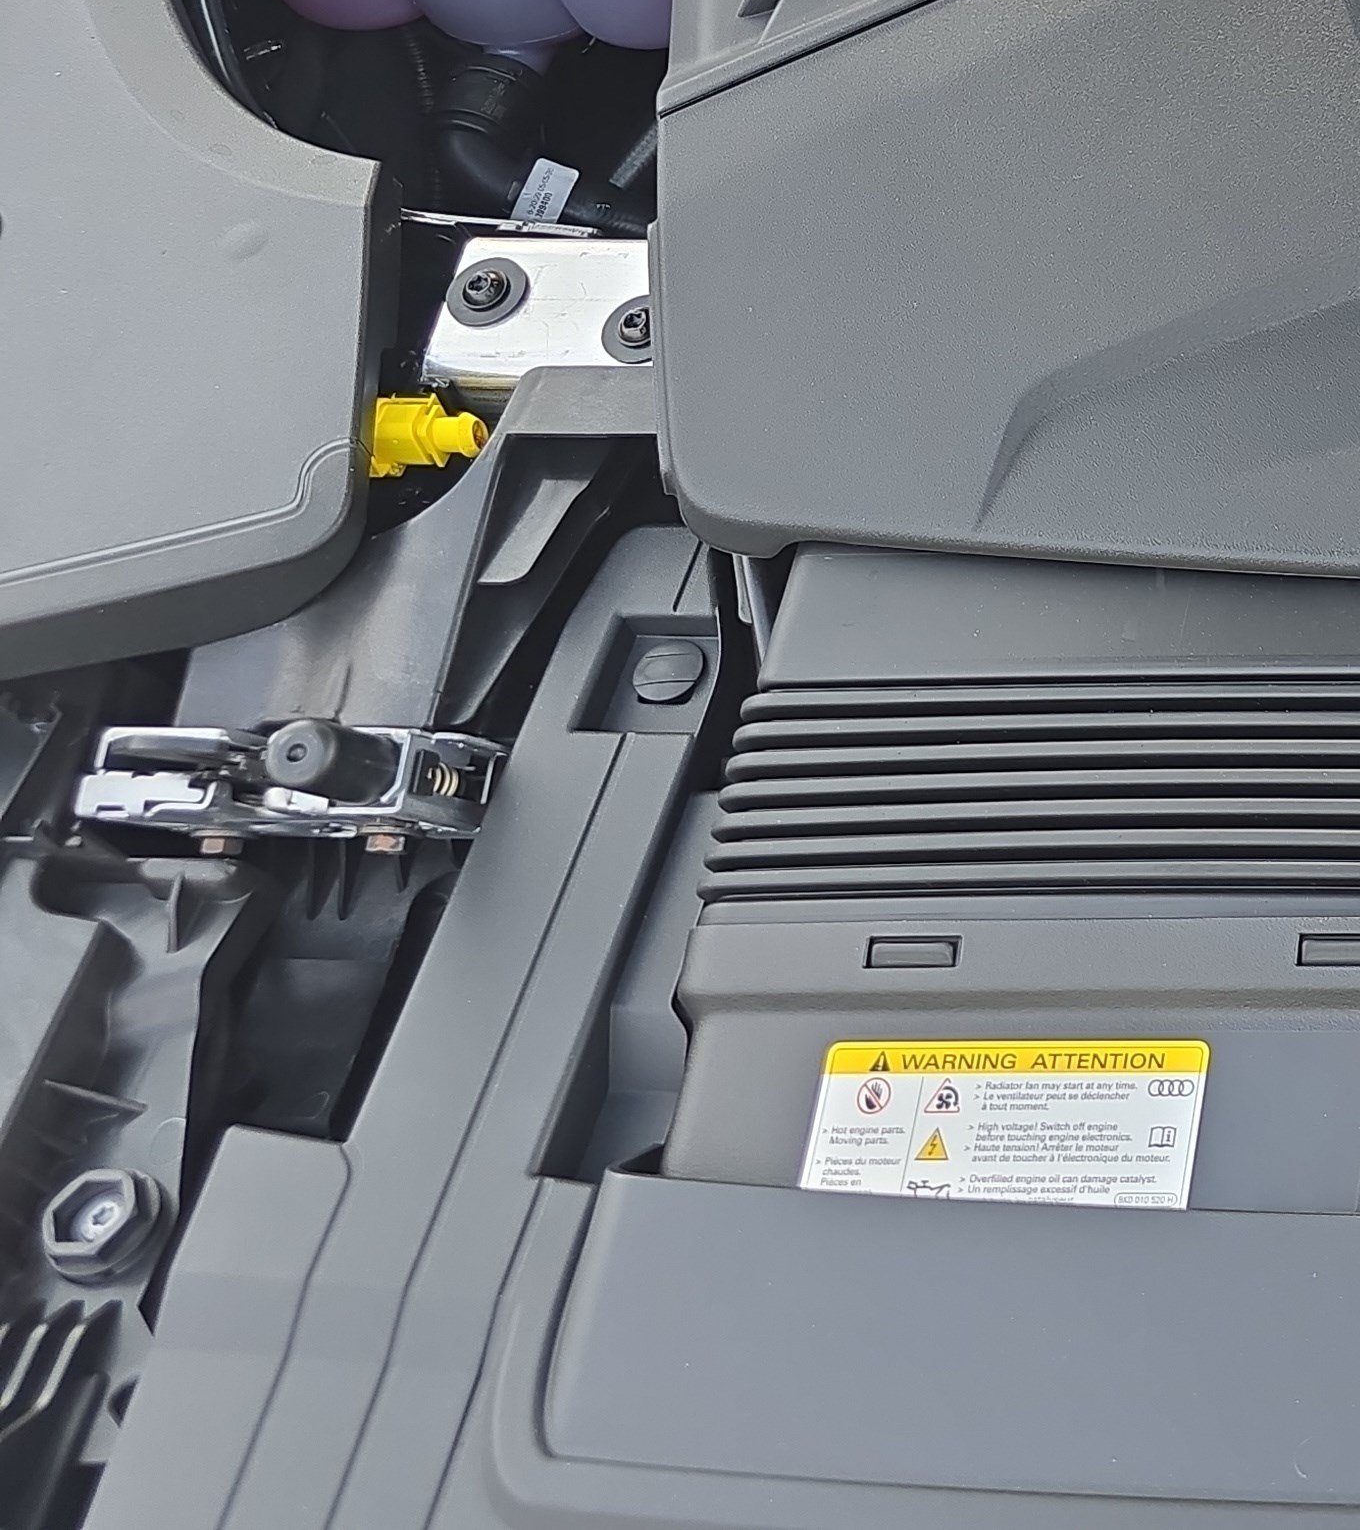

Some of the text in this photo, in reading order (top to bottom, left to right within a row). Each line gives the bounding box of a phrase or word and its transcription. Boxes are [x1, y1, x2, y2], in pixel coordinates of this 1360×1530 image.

[902, 1053, 1166, 1070] WARNING ATTENTION
[985, 1081, 1138, 1092] Radiator fan may start at any time.
[983, 1092, 994, 1100] Le
[996, 1092, 1043, 1100] ventilateur
[1046, 1093, 1066, 1102] peut
[1081, 1091, 1130, 1100] déclencher
[981, 1102, 1049, 1111] à tout moment.
[831, 1126, 905, 1136] Hot engine parts.
[977, 1122, 1118, 1134] High voltage! Switch off engine
[829, 1136, 862, 1146] Moving
[975, 1133, 1133, 1143] before touching engine electronics.
[973, 1143, 1119, 1152] Haute tension! Arrêter le moteur
[854, 1157, 866, 1165] du
[868, 1157, 902, 1165] moteur
[972, 1153, 1170, 1164] avant de toucher à l'électronique du moteur.
[969, 1174, 1157, 1186] Overfilled engine oil can damage catalyst.
[967, 1185, 1110, 1196] Un remplissage excessif d'huile
